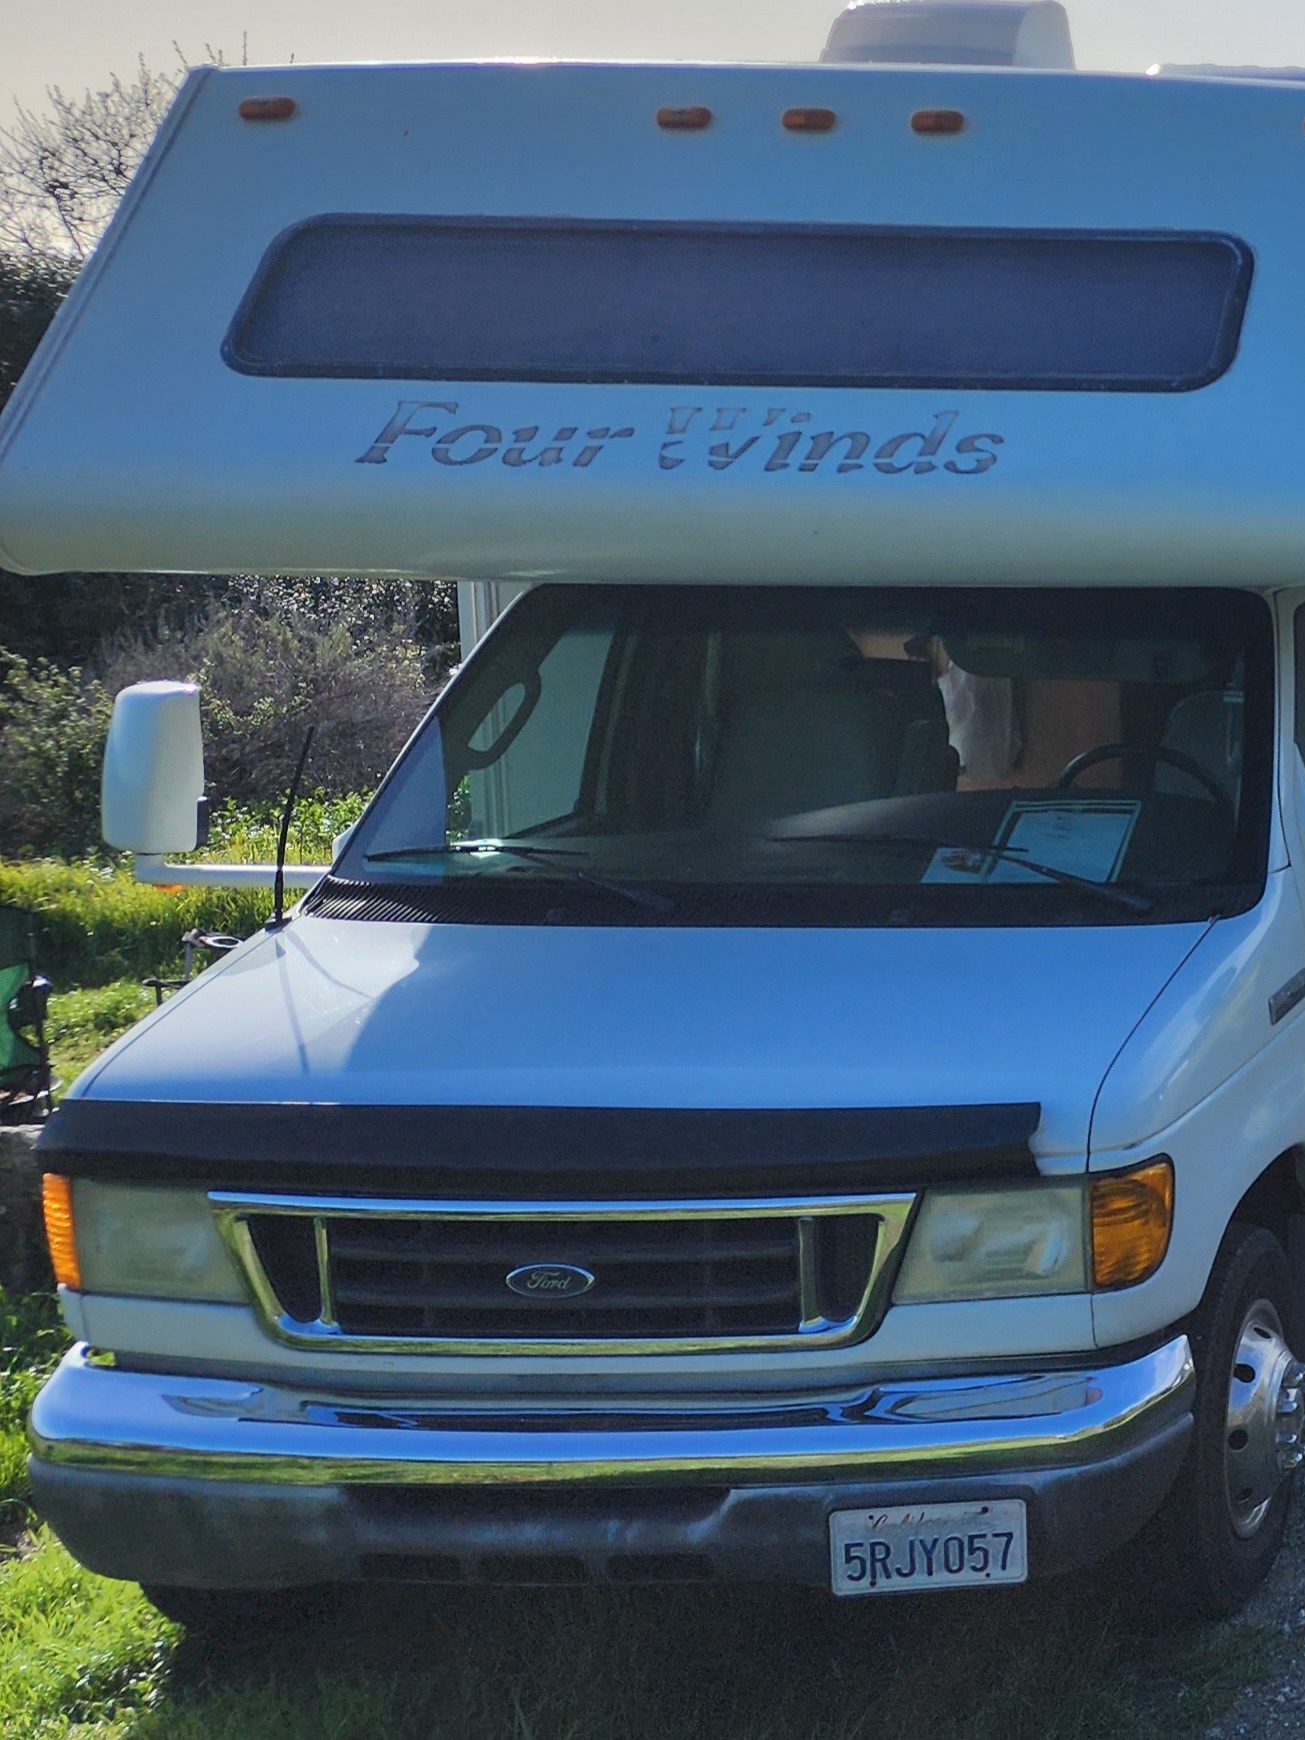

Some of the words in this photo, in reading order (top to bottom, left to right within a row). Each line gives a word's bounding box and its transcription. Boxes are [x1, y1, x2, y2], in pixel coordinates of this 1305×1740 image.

[354, 400, 635, 467] Four
[658, 405, 1006, 475] Winds
[527, 1271, 572, 1290] Ford
[844, 1532, 1014, 1582] 5RJY057
